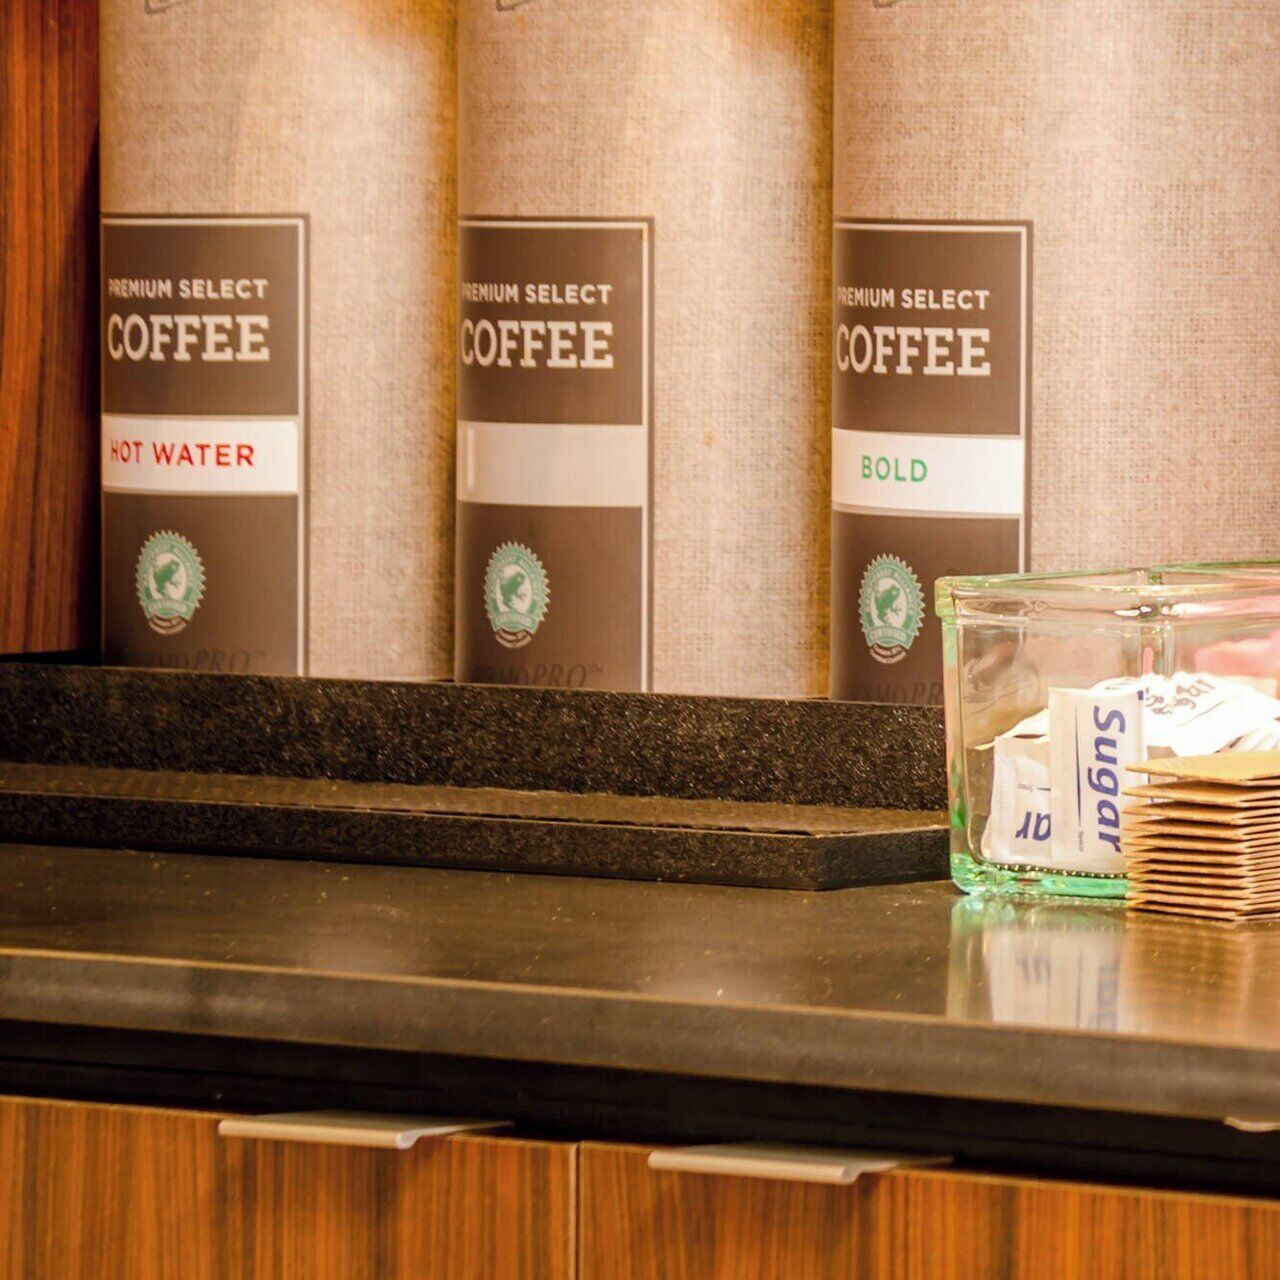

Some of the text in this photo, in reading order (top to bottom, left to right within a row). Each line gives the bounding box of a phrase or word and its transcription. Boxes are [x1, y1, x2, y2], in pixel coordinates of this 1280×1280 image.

[109, 278, 269, 299] PREMIUM SELECT
[462, 282, 613, 305] PREMIUM SELECT
[837, 286, 991, 310] PREMIUM SELECT
[107, 313, 270, 363] COFFEE
[461, 318, 614, 369] COFFEE
[836, 323, 992, 377] COFFEE
[110, 440, 255, 467] HOT WATER
[861, 455, 928, 483] BOLD
[1087, 705, 1127, 853] Sugar
